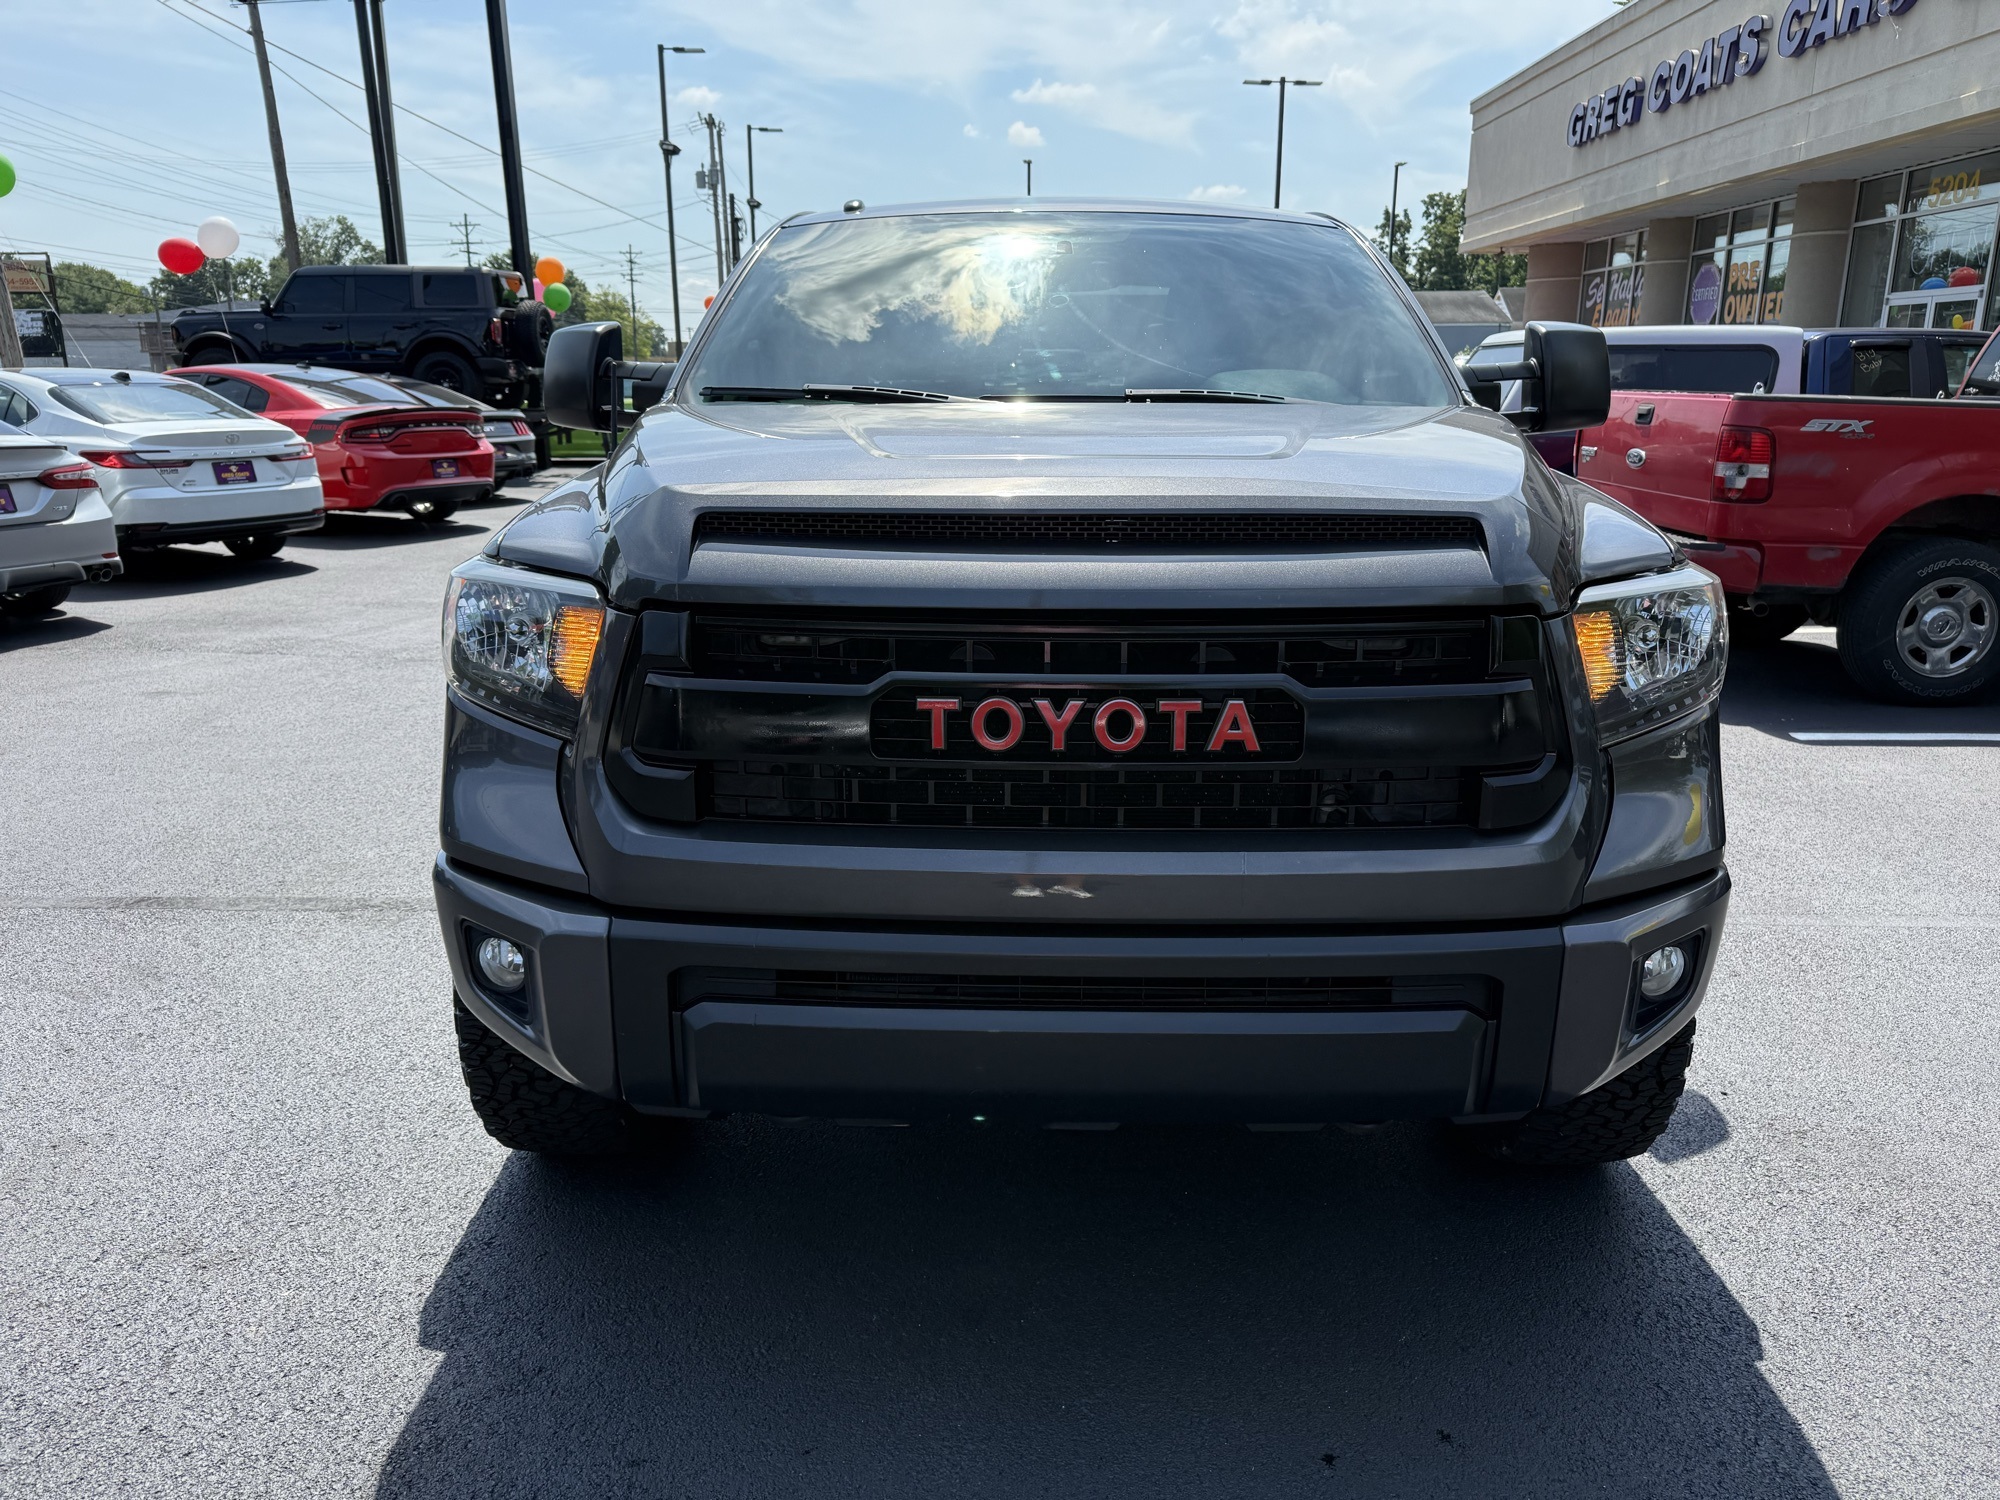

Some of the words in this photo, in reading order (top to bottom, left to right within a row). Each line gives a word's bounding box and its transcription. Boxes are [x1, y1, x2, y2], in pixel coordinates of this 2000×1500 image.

[1567, 76, 1645, 148] GREG
[1647, 14, 1773, 114] COATS
[1927, 168, 1981, 208] 5204
[1727, 260, 1760, 292] PRE
[1692, 286, 1719, 303] CERTIFIED
[1855, 348, 1877, 362] Big
[1860, 357, 1883, 373] Baby
[1800, 418, 1875, 433] STX
[916, 697, 1261, 751] TOYOTA
